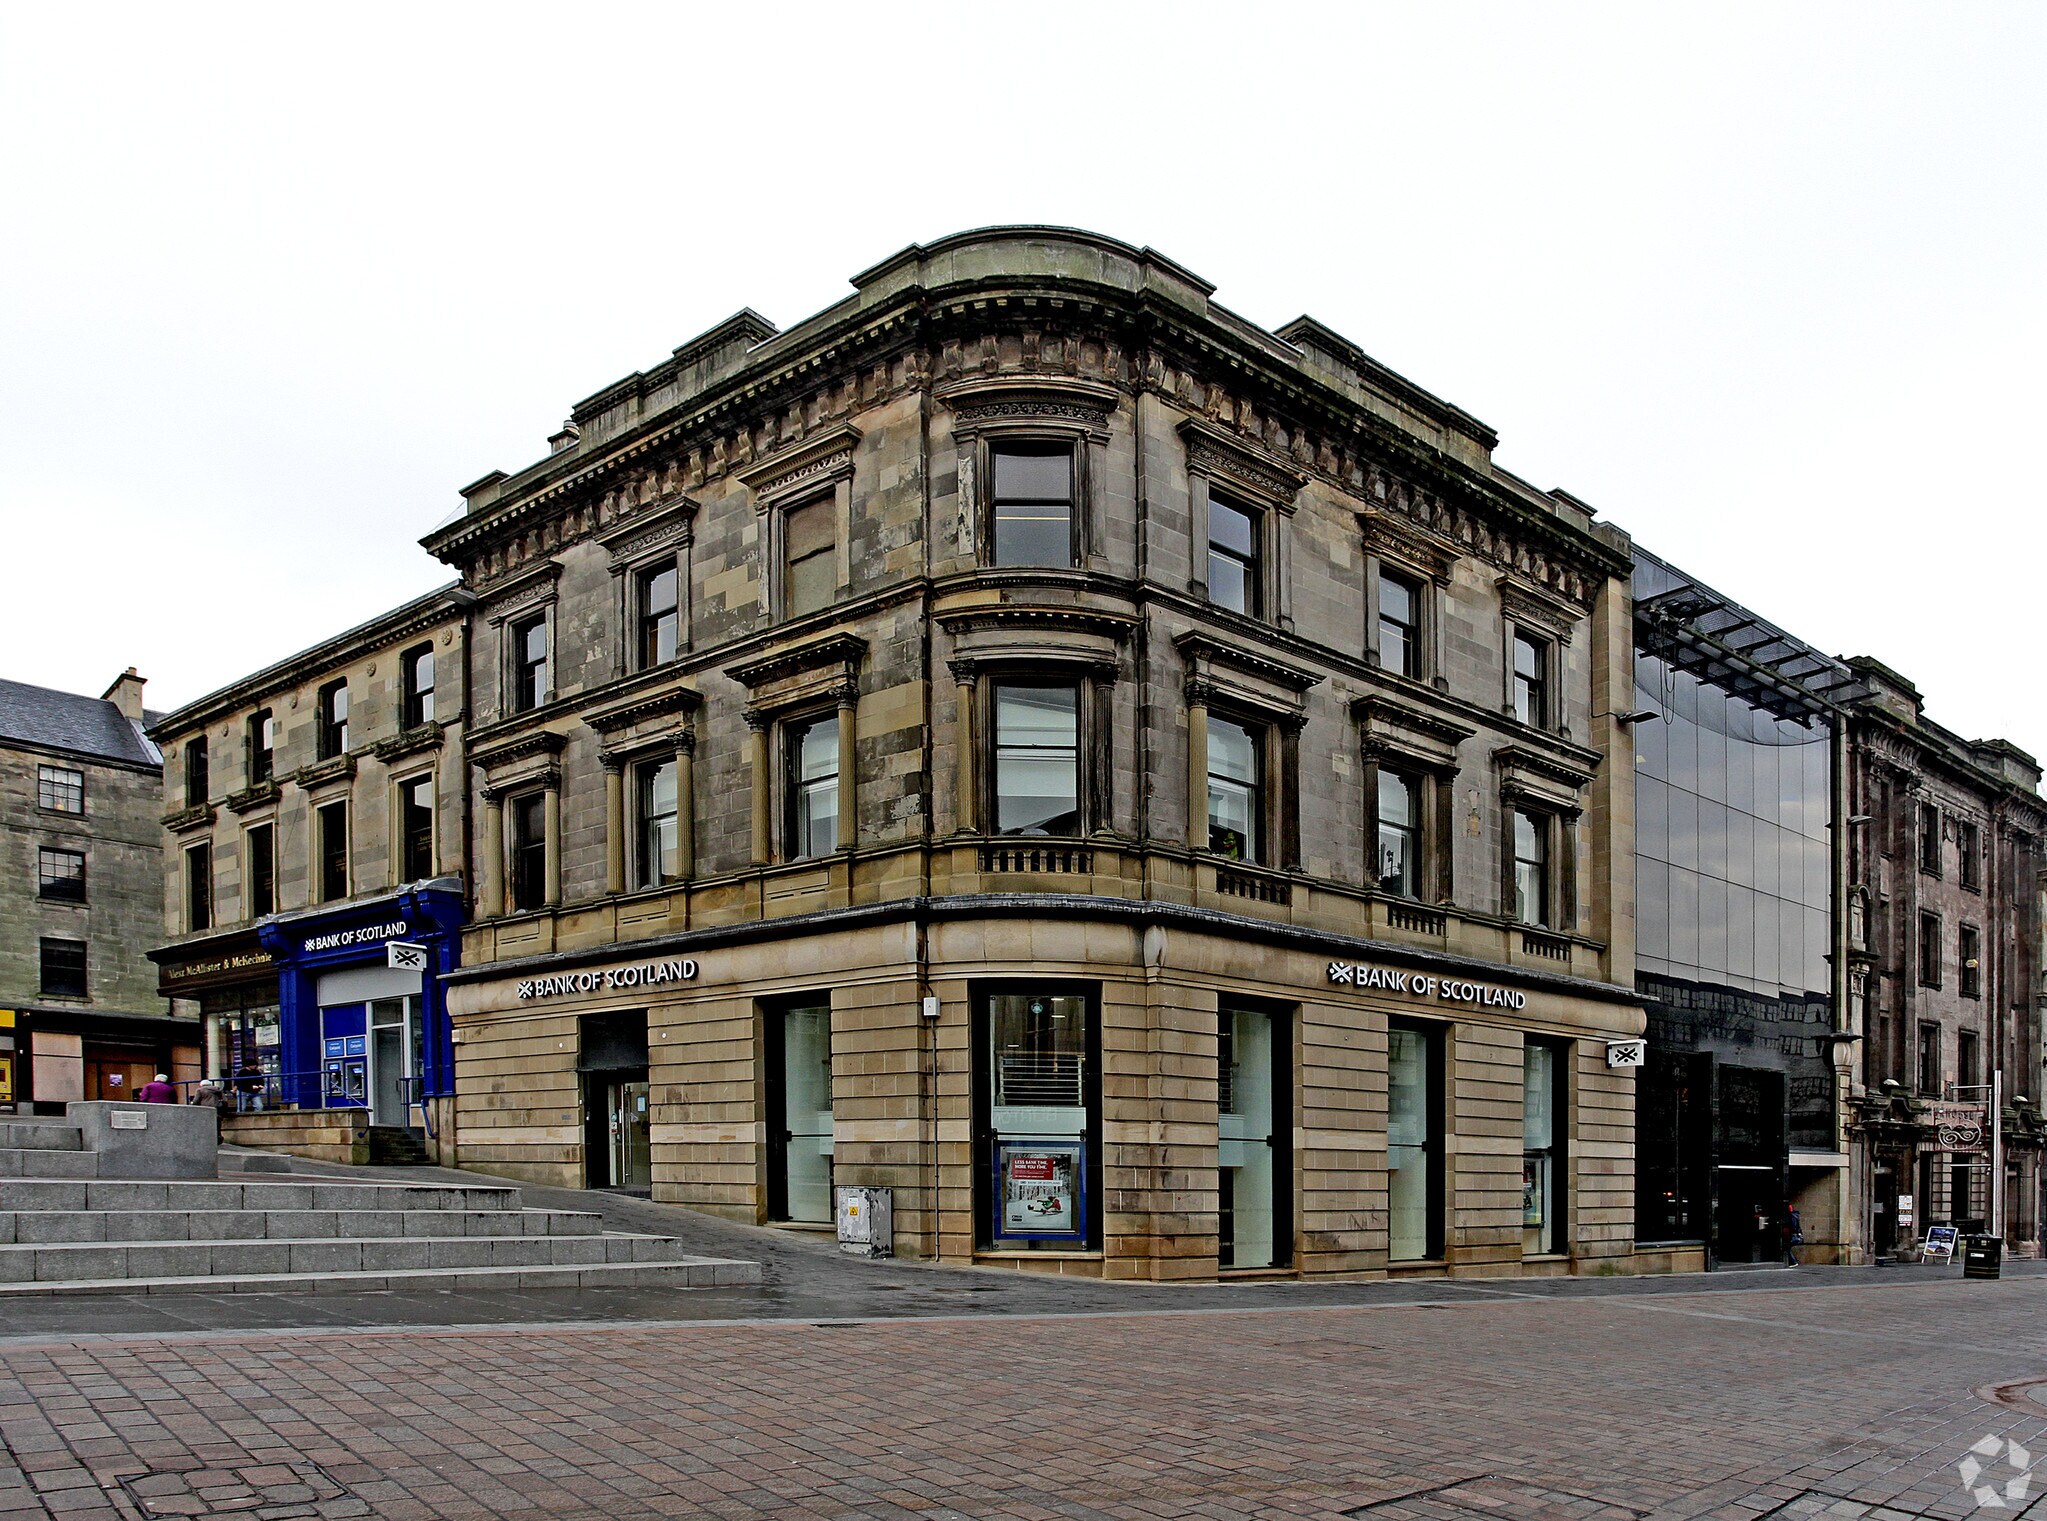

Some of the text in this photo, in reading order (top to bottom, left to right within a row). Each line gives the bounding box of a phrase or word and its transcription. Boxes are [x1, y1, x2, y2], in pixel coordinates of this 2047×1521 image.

[316, 921, 407, 950] BANK OF SCOTLAND
[186, 962, 221, 976] McAllister
[223, 959, 229, 969] &
[231, 952, 272, 968] McKechnie
[535, 959, 697, 996] BANK OF SCOTLAND
[1356, 965, 1526, 1009] BANK OF SCOTLAND
